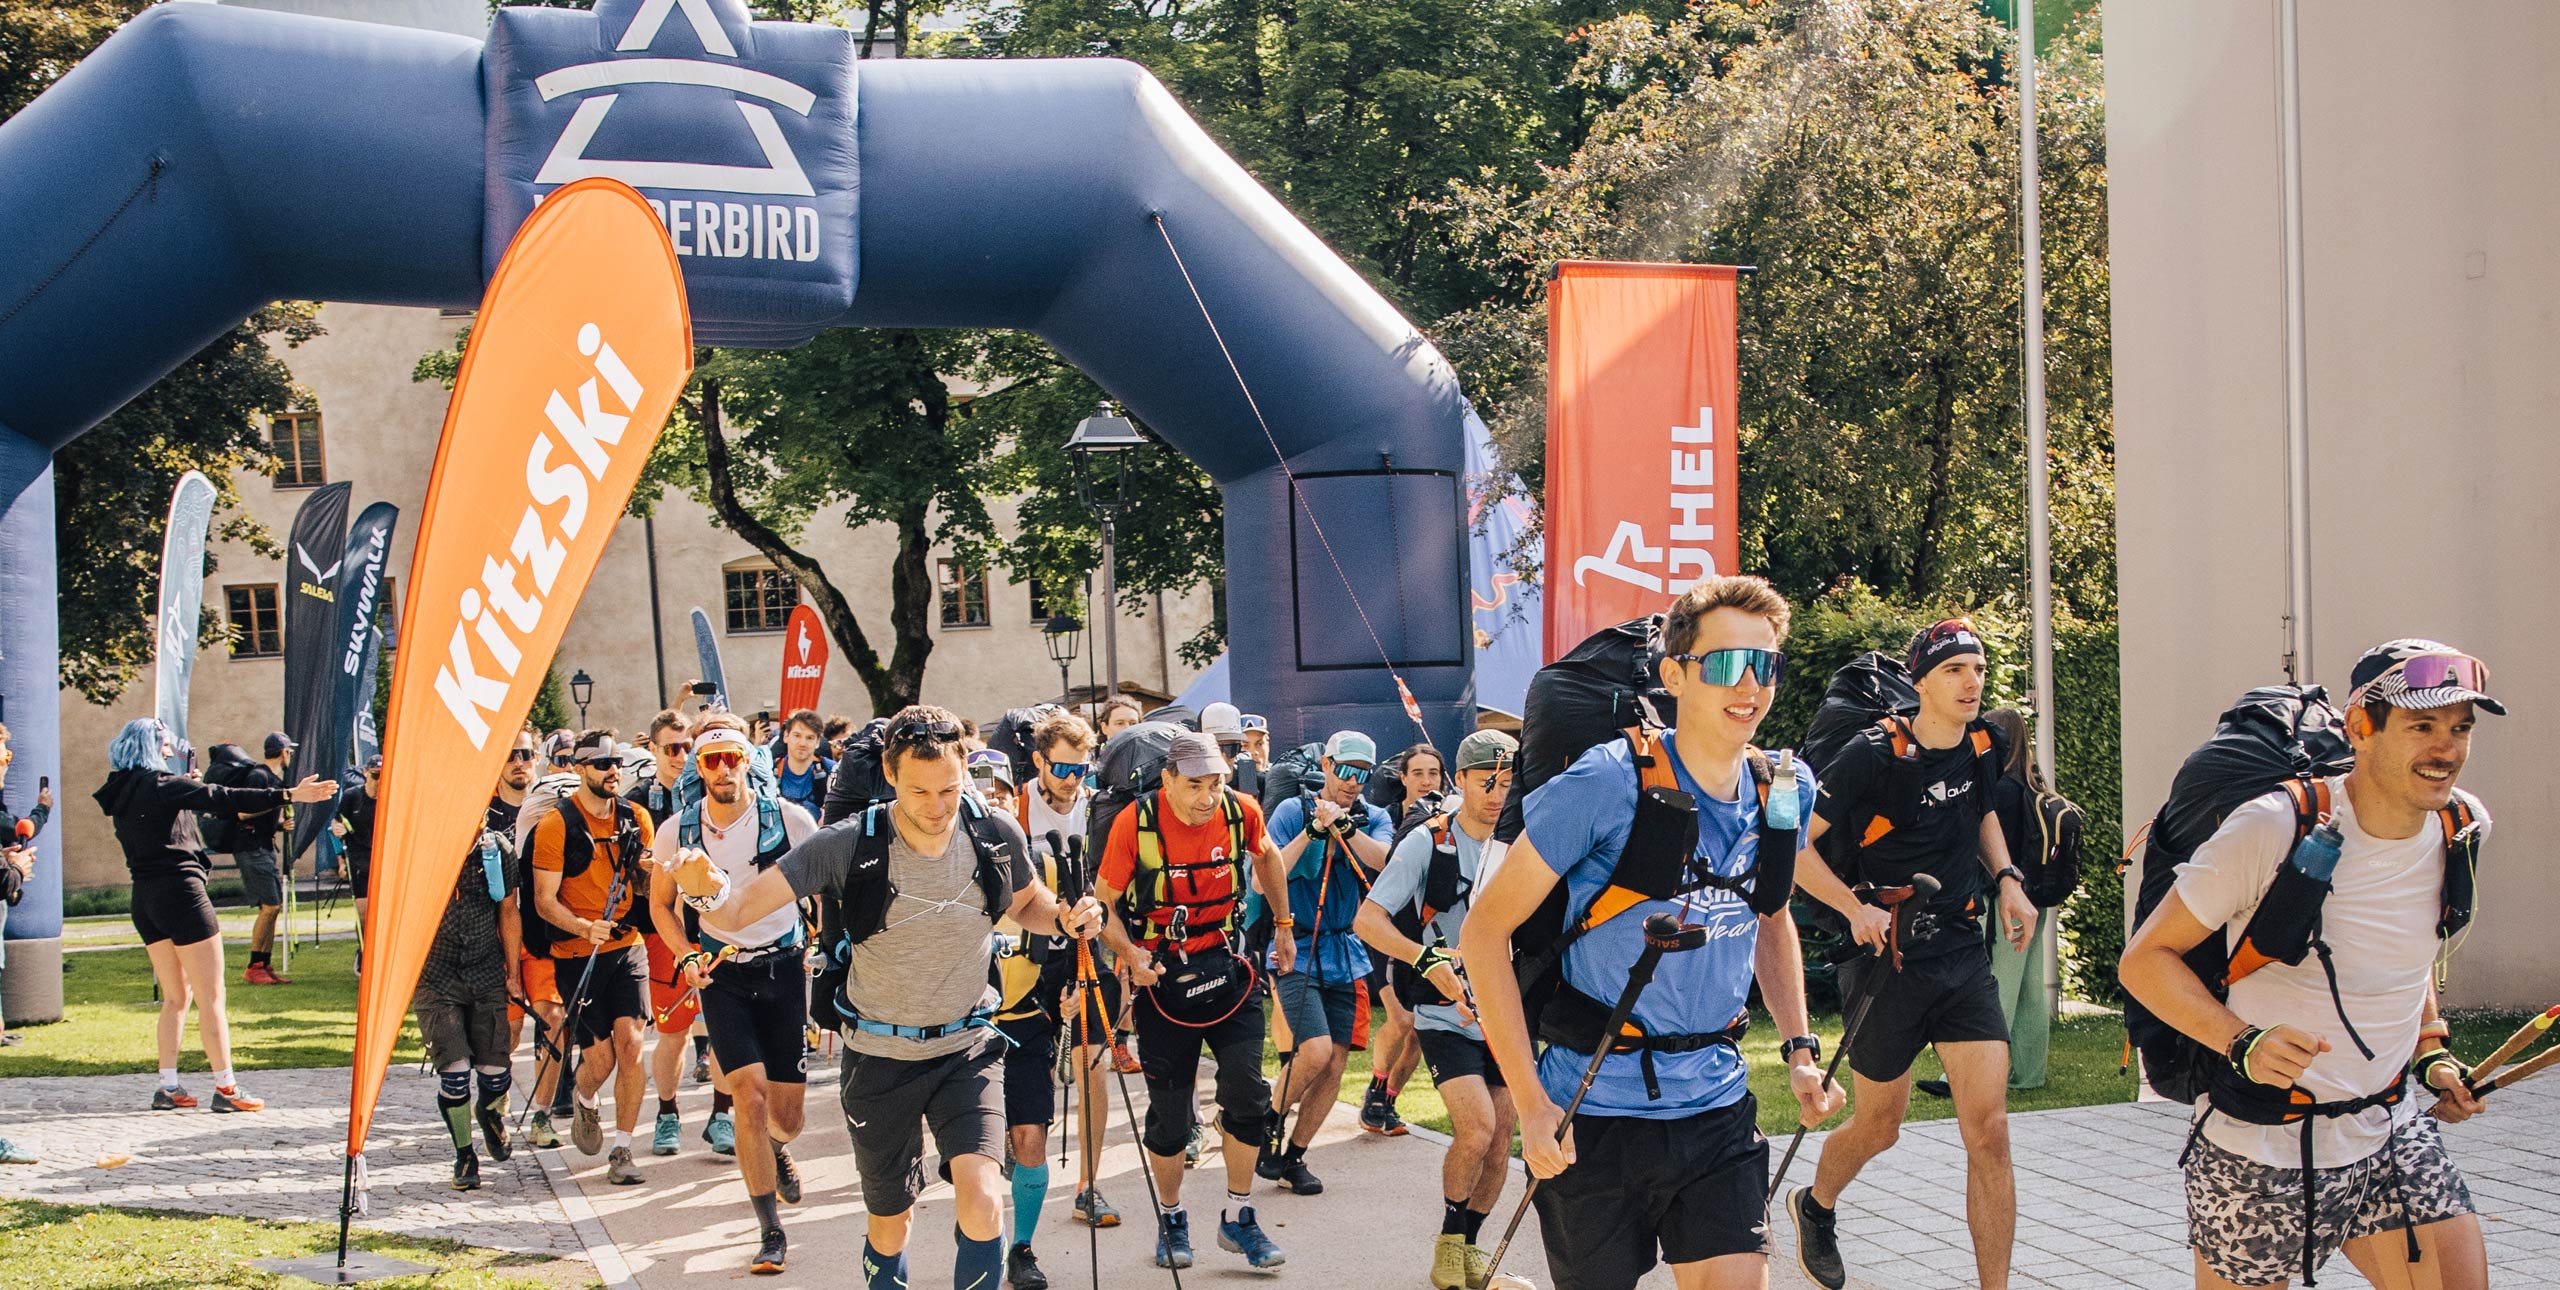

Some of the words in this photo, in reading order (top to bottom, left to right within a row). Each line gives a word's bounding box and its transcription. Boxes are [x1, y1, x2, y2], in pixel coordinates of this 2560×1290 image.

[433, 322, 644, 752] KitzSki
[1668, 406, 1715, 595] UHEL
[787, 665, 821, 679] KitzSki
[1645, 935, 1680, 949] SALO
